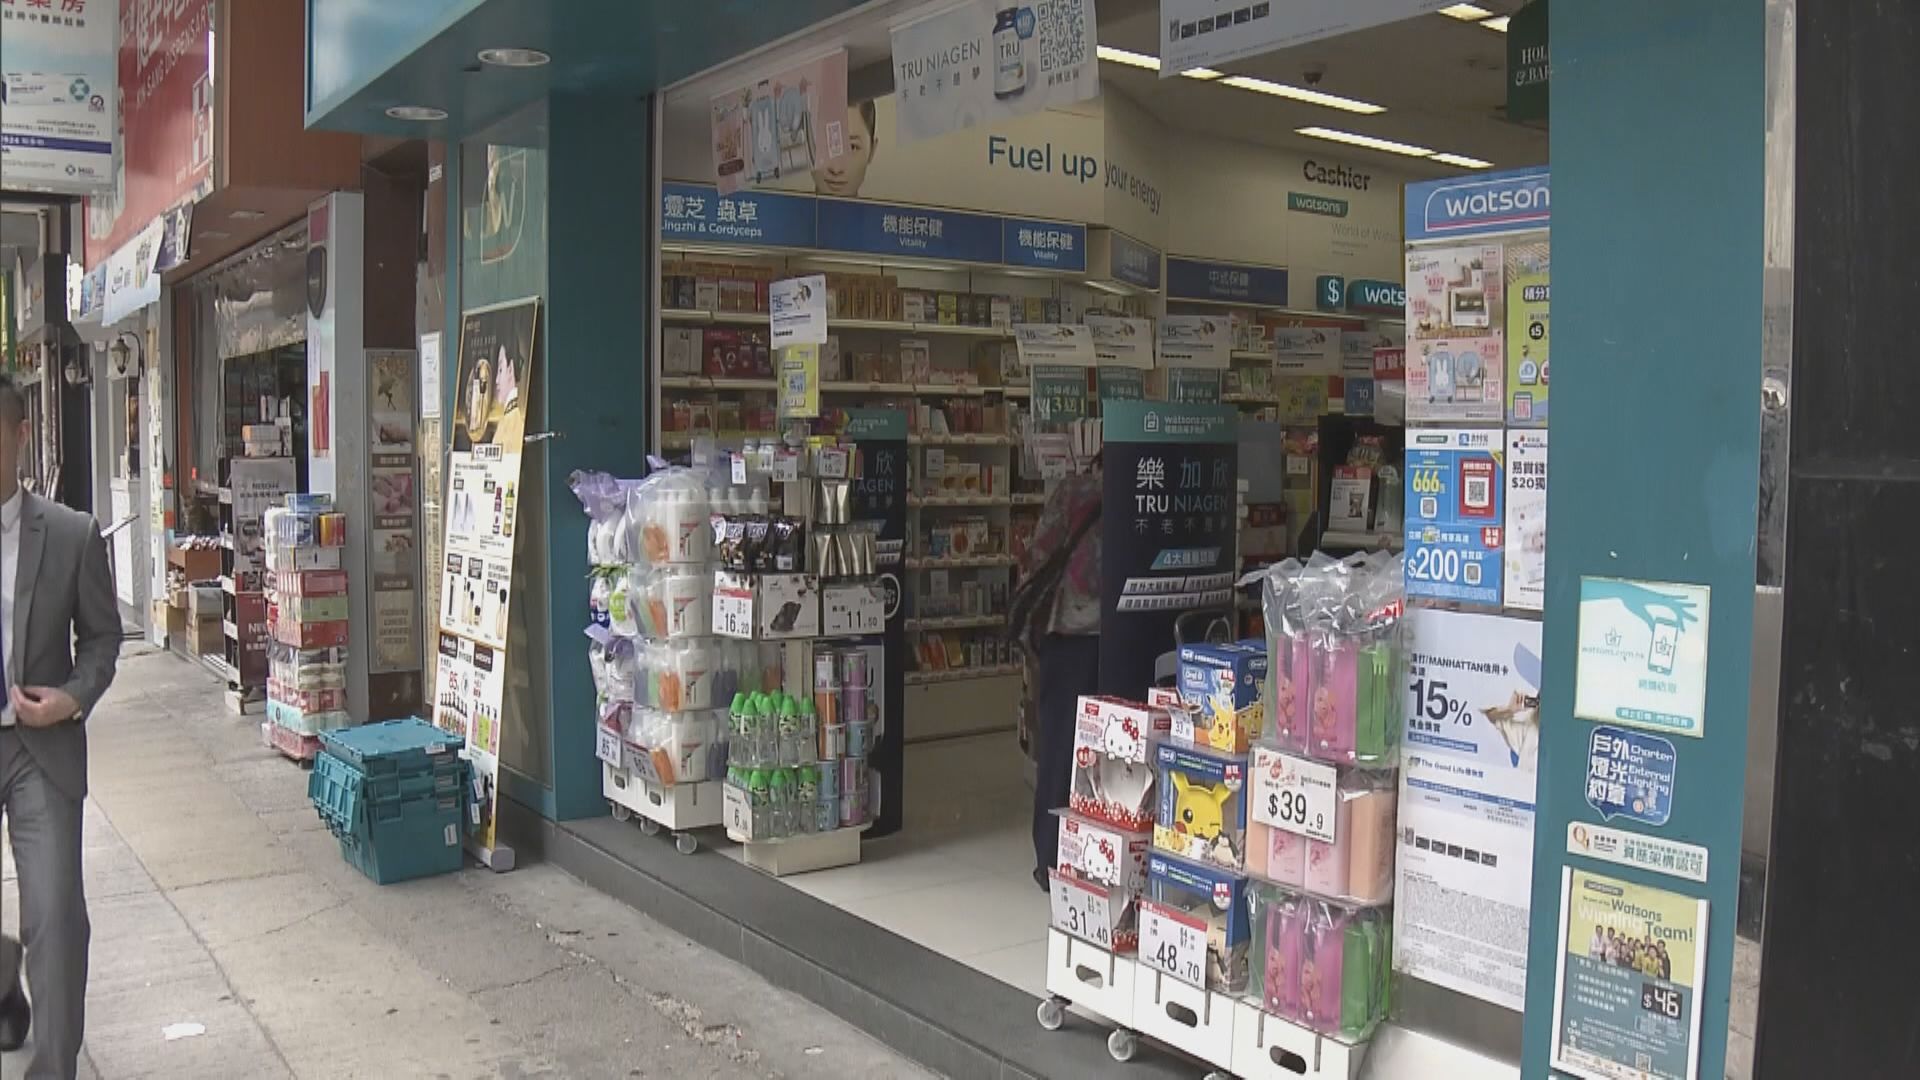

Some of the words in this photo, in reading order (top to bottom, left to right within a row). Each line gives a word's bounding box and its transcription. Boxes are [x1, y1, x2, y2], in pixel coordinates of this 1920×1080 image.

[901, 57, 923, 80] TRU
[926, 39, 981, 72] NIAGEN
[999, 42, 1020, 60] TRU
[1515, 71, 1526, 87] &
[990, 135, 1052, 180] Fuel
[1061, 149, 1098, 188] up
[1104, 163, 1128, 198] your
[1130, 172, 1162, 215] energy
[1303, 159, 1371, 191] Cashier
[664, 195, 706, 219] 靈芝
[717, 198, 758, 224] 蟲草
[1295, 196, 1341, 215] watsons
[1446, 186, 1549, 218] watson
[662, 219, 696, 233] ingzhi
[699, 223, 706, 232] &
[709, 223, 762, 238] Cordyceps
[882, 212, 943, 236] 機能保健
[899, 236, 928, 248] Vitality
[1018, 228, 1073, 251] 機能保健
[1034, 250, 1059, 261] Vitality
[1327, 278, 1342, 305] $
[1363, 284, 1406, 306] wats
[1135, 457, 1229, 491] 樂加欣
[1412, 469, 1440, 493] 666
[1134, 495, 1169, 514] TRU
[1172, 495, 1228, 513] NIAGEN
[1407, 547, 1459, 582] $200
[724, 612, 750, 634] 16.20
[847, 609, 878, 629] 11.50
[1409, 679, 1473, 727] 15%
[1630, 755, 1643, 765] on
[1631, 745, 1673, 762] Charter
[1629, 765, 1671, 783] External
[1628, 776, 1669, 797] Lighting
[1267, 790, 1324, 830] $39.9
[1612, 899, 1662, 922] Watsons
[1068, 905, 1108, 944] 31.40
[1645, 920, 1692, 943] Team!
[1156, 940, 1200, 982] 48.70
[1643, 987, 1678, 1019] $46
